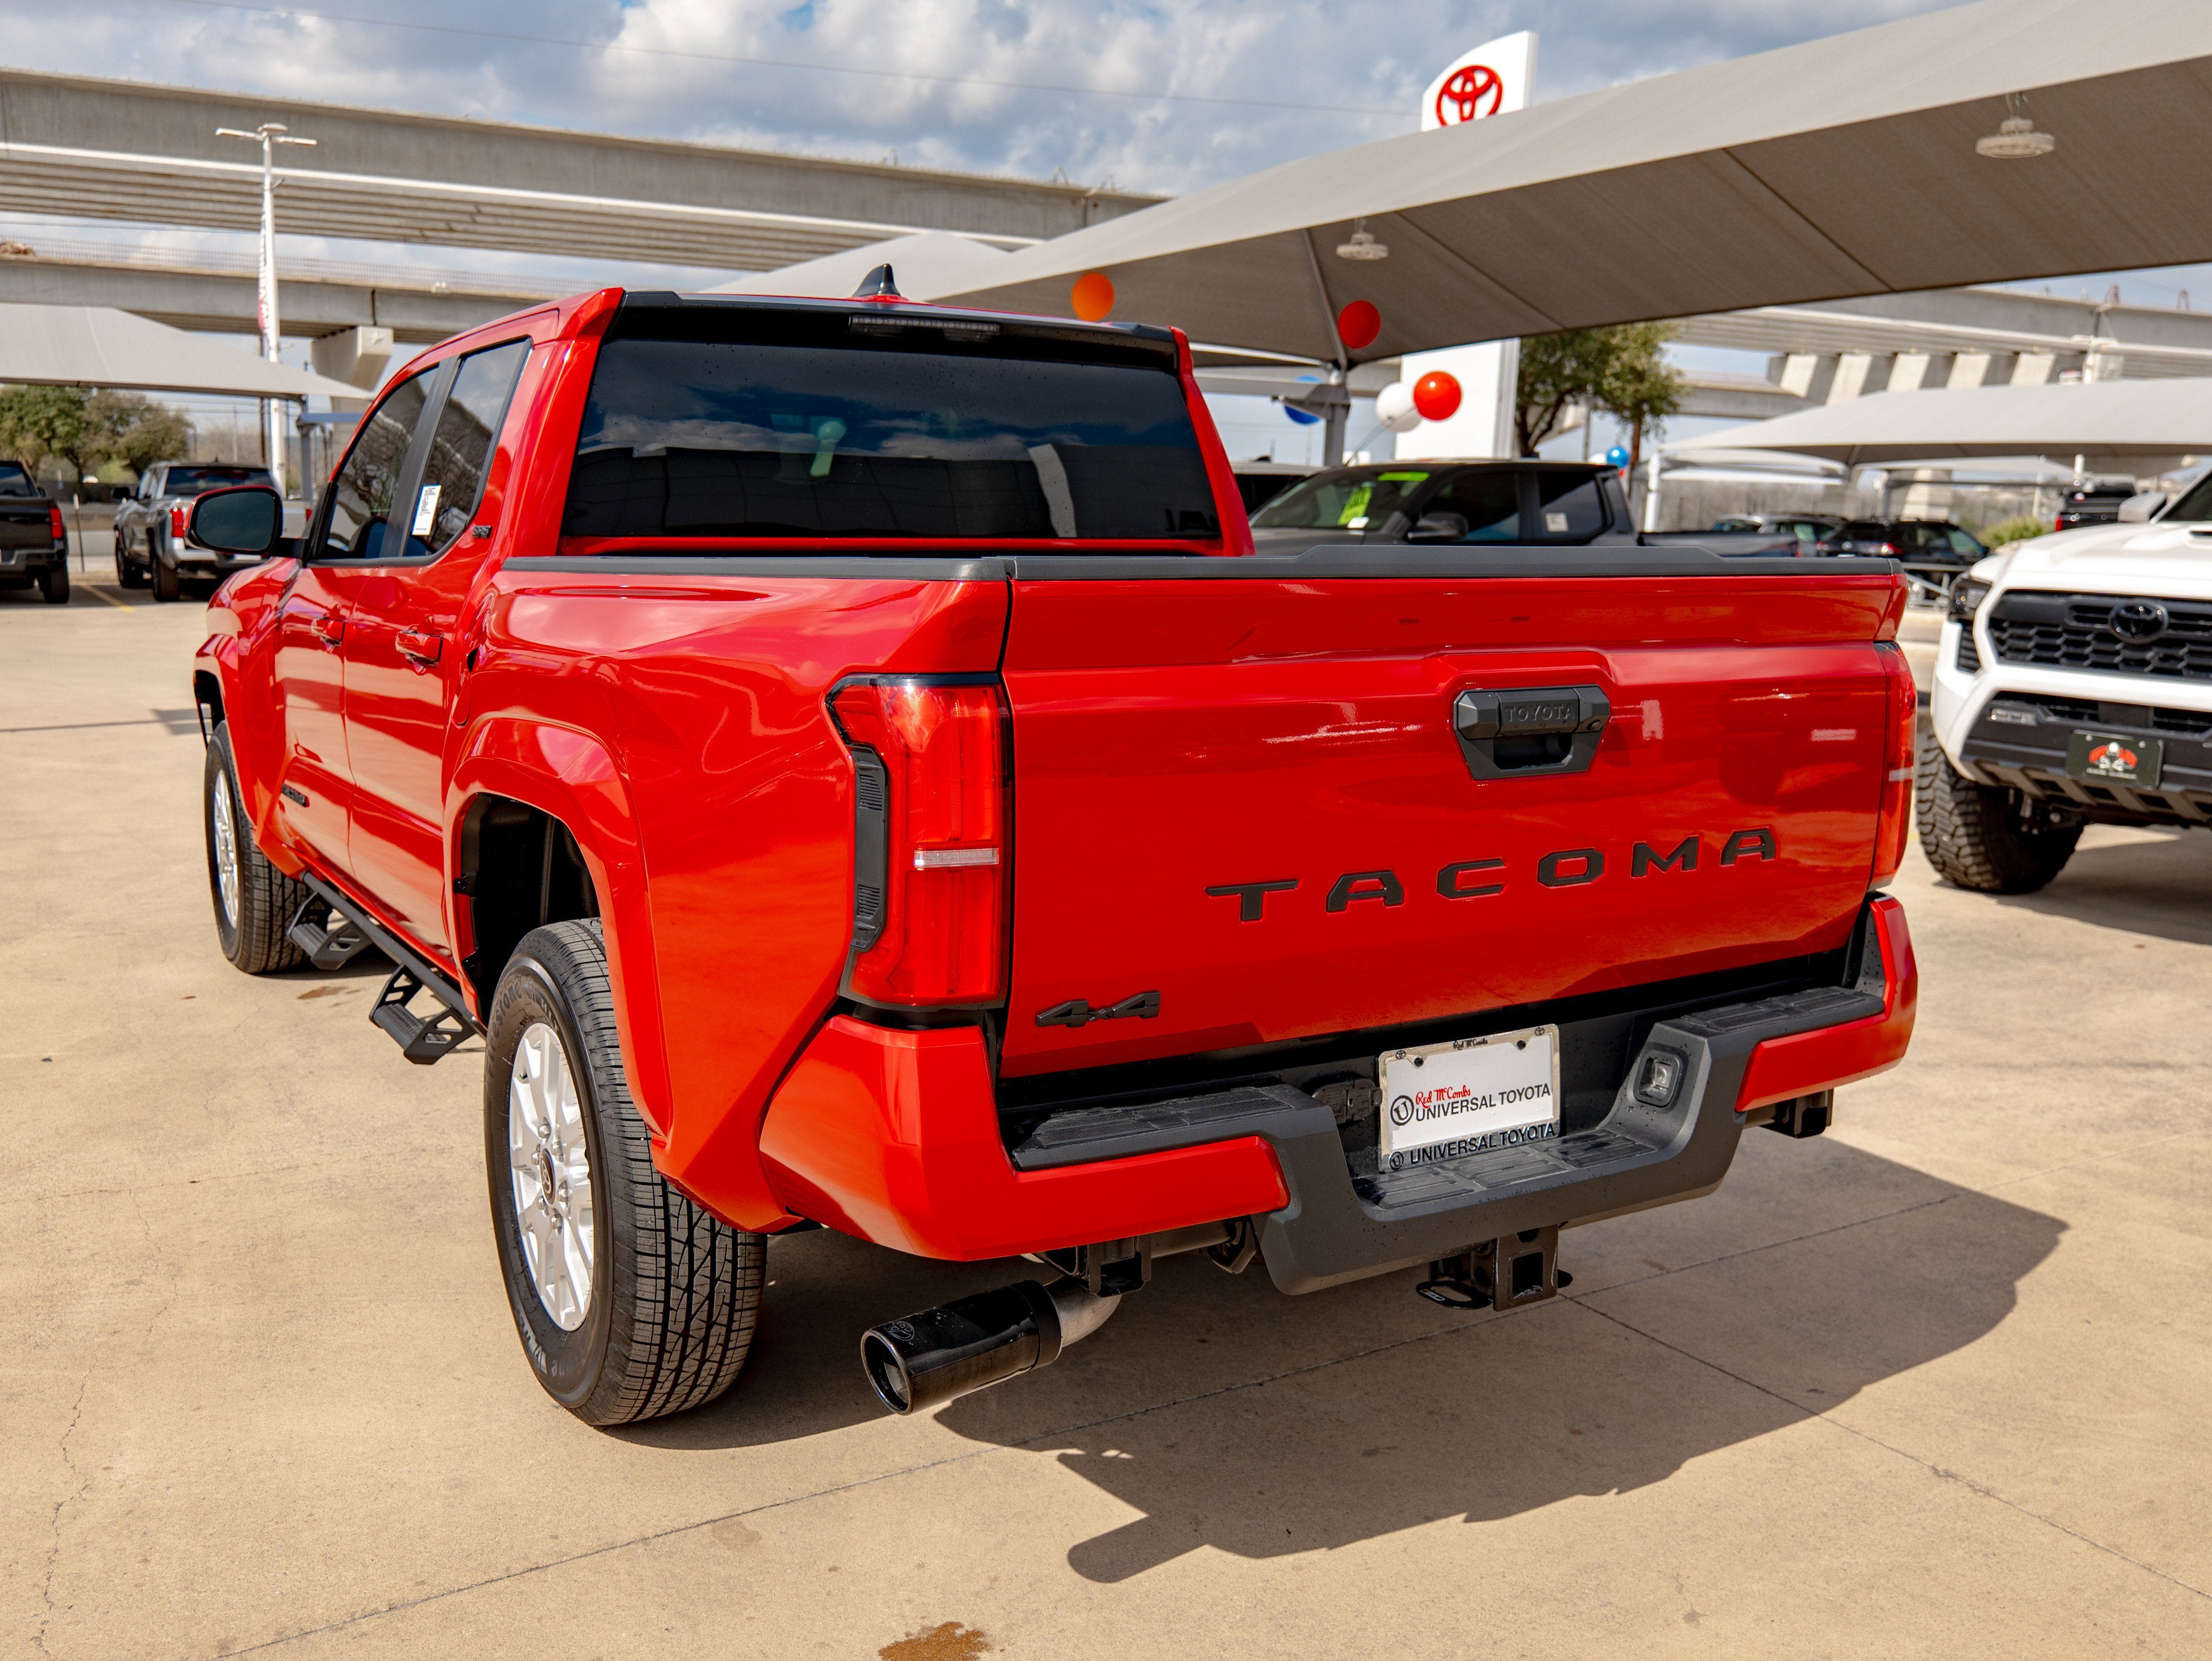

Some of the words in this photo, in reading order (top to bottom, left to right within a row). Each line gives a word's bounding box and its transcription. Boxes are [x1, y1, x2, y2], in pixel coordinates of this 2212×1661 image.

[1505, 702, 1575, 722] TOYOTA
[1204, 827, 1778, 922] TACOMA
[1453, 1041, 1464, 1050] Red
[1415, 1091, 1432, 1108] Red
[1433, 1084, 1471, 1102] McCombs
[1415, 1094, 1497, 1122] UNIVERSAL
[1498, 1083, 1551, 1105] TOYOTA
[1411, 1135, 1497, 1164] UNIVERSAL
[1499, 1122, 1555, 1145] TOYOTA
